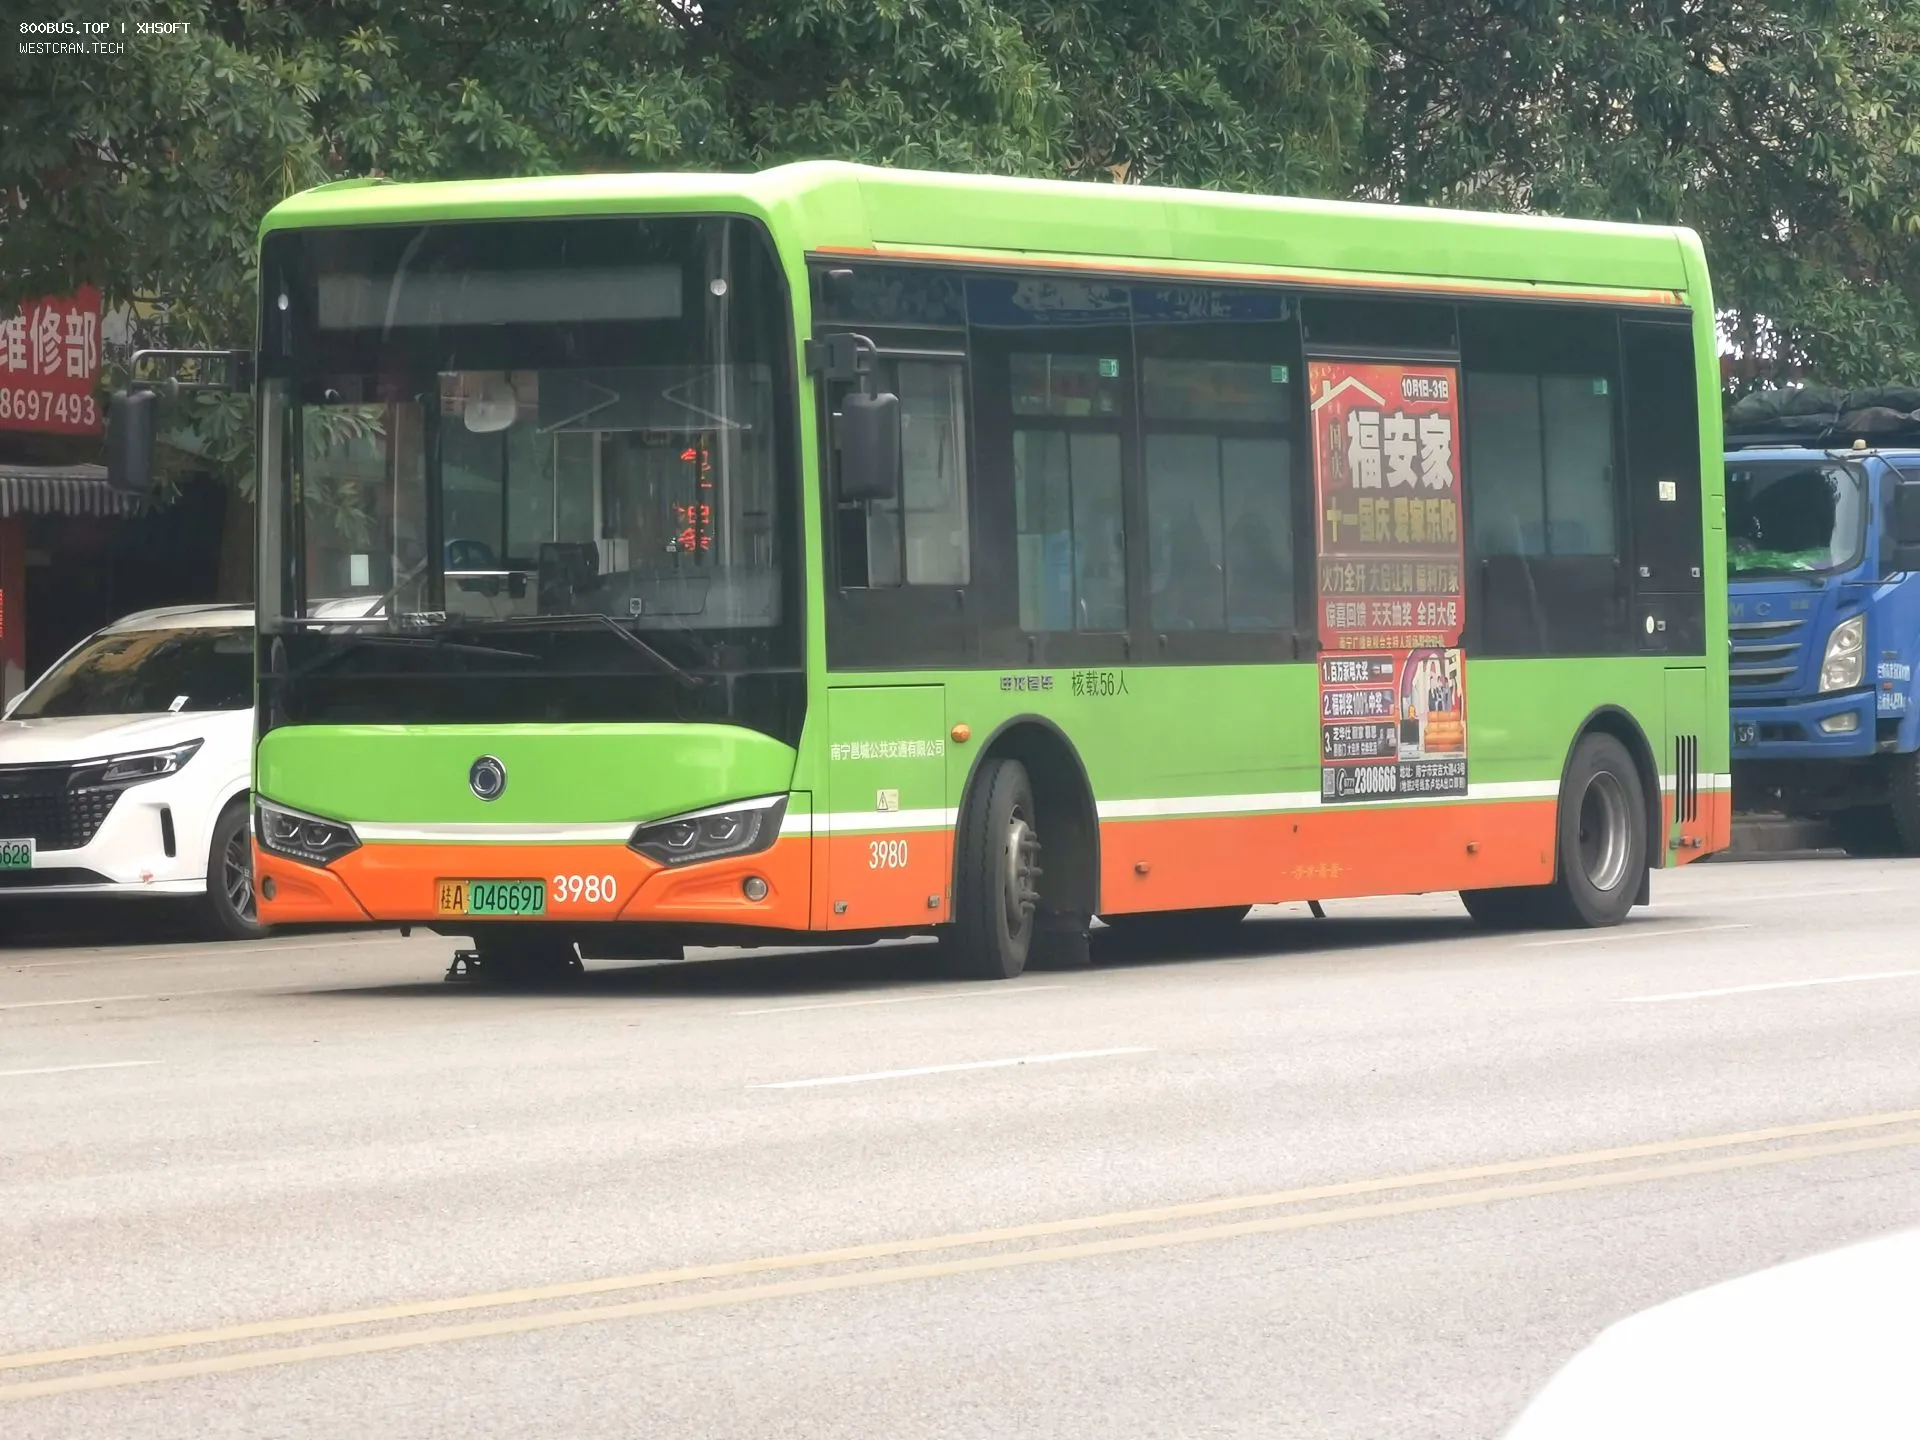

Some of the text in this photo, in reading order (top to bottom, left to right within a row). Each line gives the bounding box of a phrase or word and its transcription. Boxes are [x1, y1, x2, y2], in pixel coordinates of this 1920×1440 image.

[0, 304, 97, 379] 维修部
[0, 387, 96, 426] 8697493
[1347, 410, 1454, 490] 福安家
[1326, 496, 1391, 543] 十一国庆
[1322, 563, 1365, 593] 火力全开
[1417, 601, 1457, 626] 全月大促
[1072, 670, 1129, 697] 核载56人
[830, 739, 945, 760] 南宁邕城公共交通有限公司
[1355, 766, 1397, 794] 2308666
[869, 840, 908, 869] 3980
[553, 874, 617, 903] 3980
